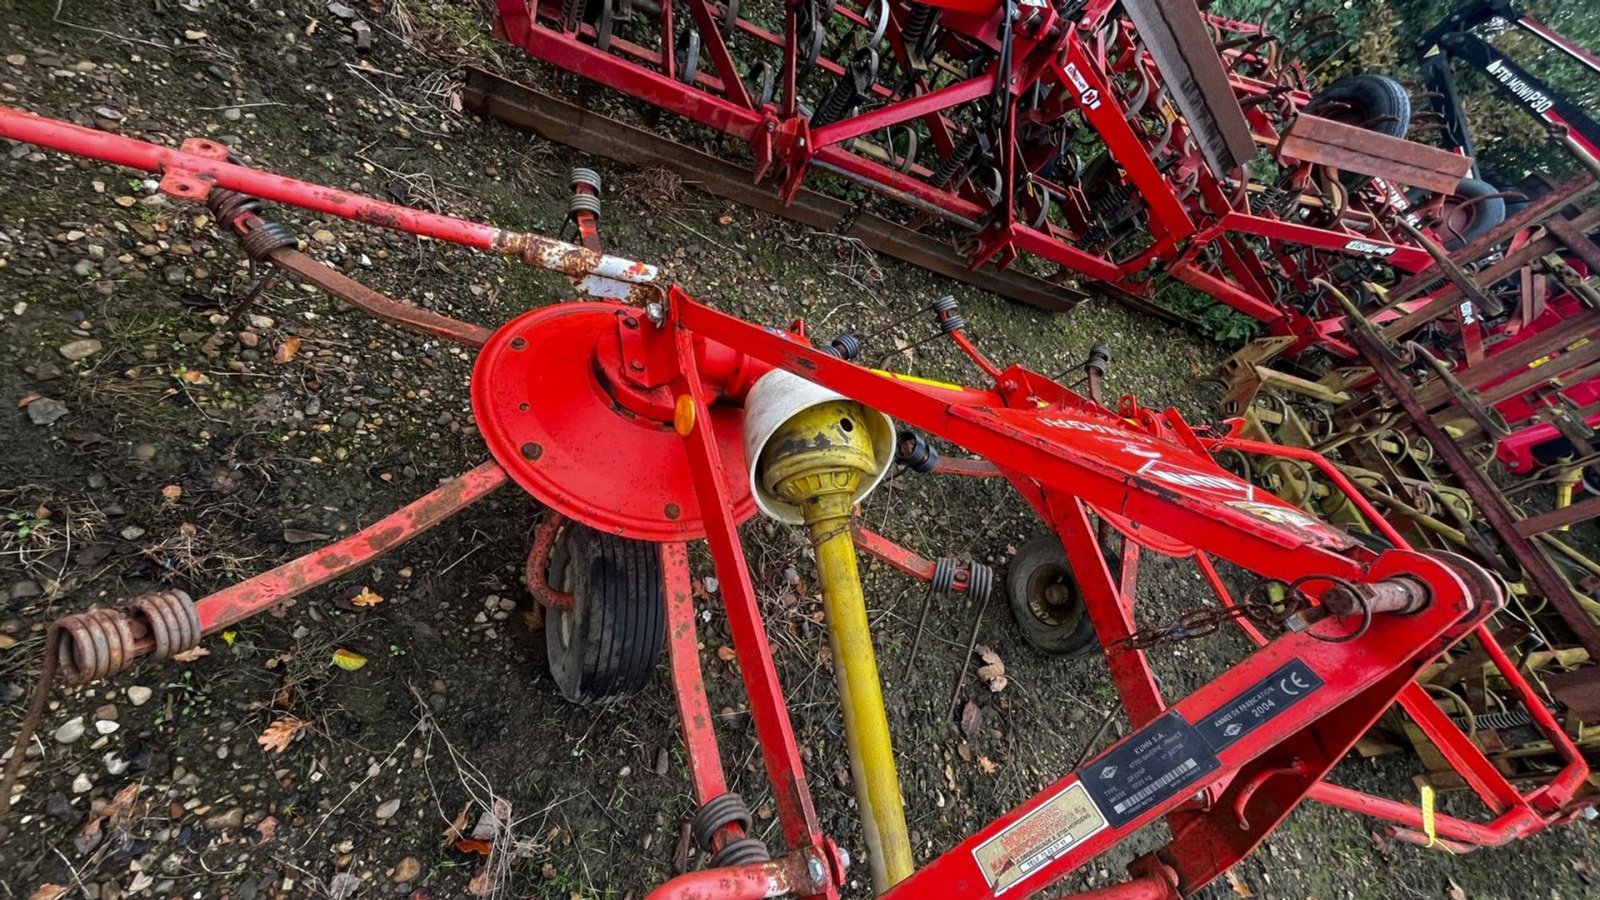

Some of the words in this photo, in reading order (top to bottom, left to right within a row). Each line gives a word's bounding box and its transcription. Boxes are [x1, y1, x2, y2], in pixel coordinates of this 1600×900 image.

[1280, 671, 1310, 695] CE
[1251, 698, 1276, 718] 2004
[1132, 739, 1153, 755] KUHN
[1000, 804, 1062, 850] HORSENS
